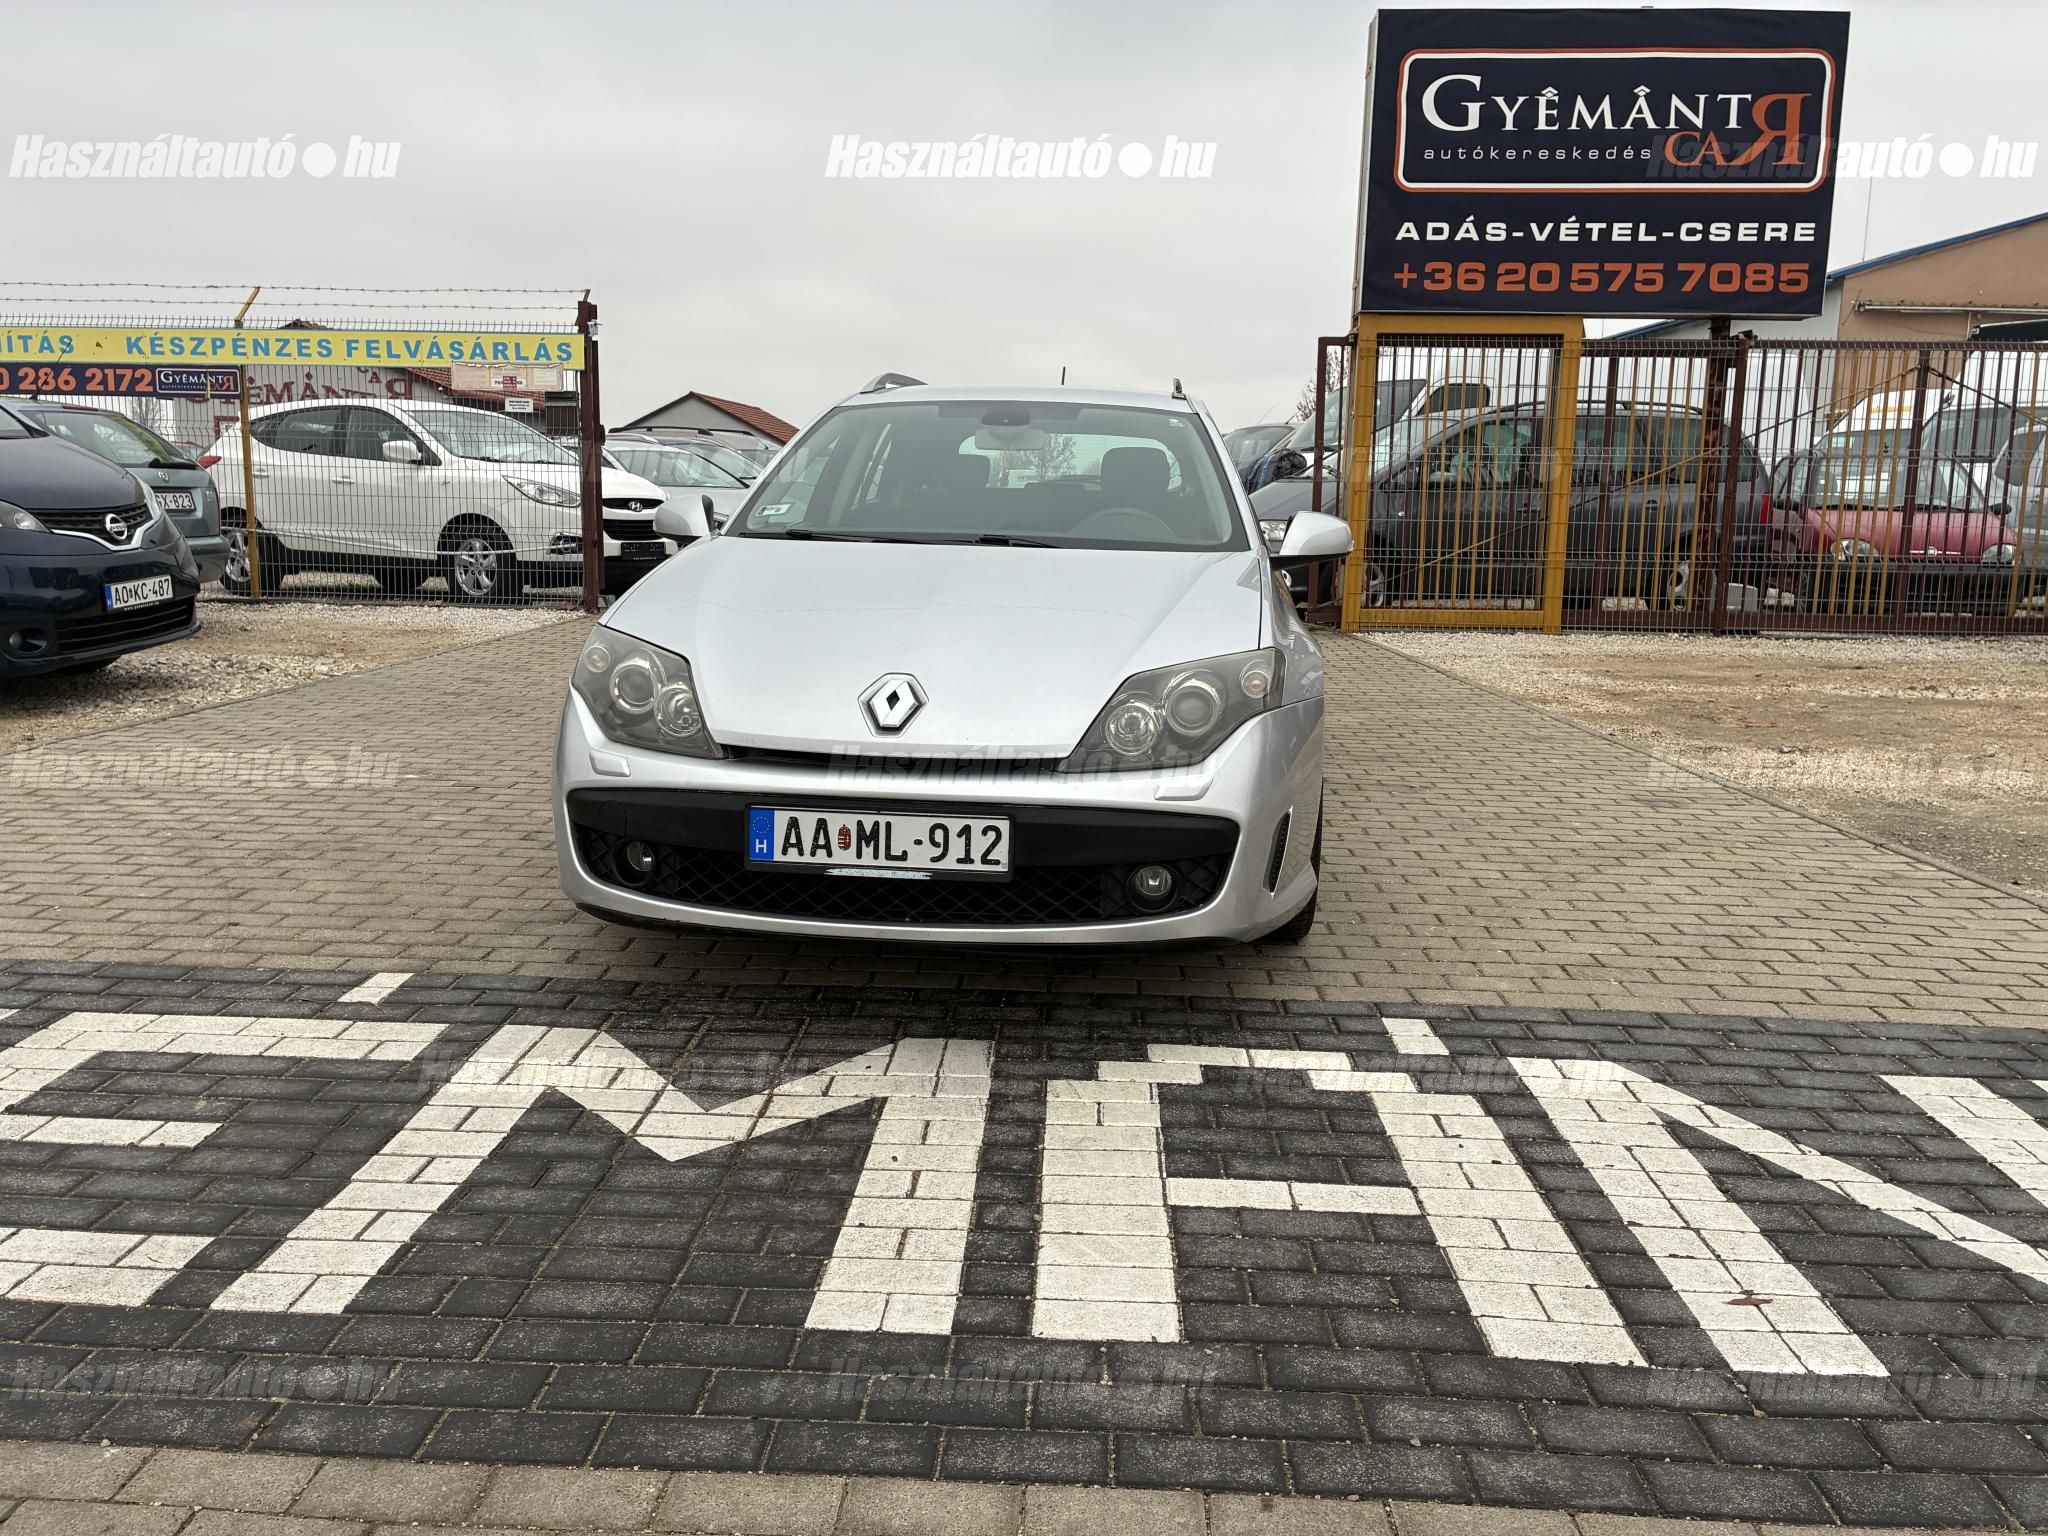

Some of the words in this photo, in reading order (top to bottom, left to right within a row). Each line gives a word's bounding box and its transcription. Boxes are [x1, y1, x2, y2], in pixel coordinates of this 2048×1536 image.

[1424, 144, 1651, 161] autókereskedés
[1393, 262, 1486, 291] +36
[1496, 263, 1560, 292] 20
[1569, 263, 1664, 292] 575
[1677, 263, 1809, 293] 7085
[0, 330, 75, 354] ÍTÁS
[125, 331, 334, 358] KÉSZPÉNZES
[346, 336, 573, 362] FELVÁSÁRLÁS
[17, 367, 77, 391] 286
[85, 368, 154, 392] 2172
[155, 494, 193, 508] GX-823
[755, 839, 768, 854] H
